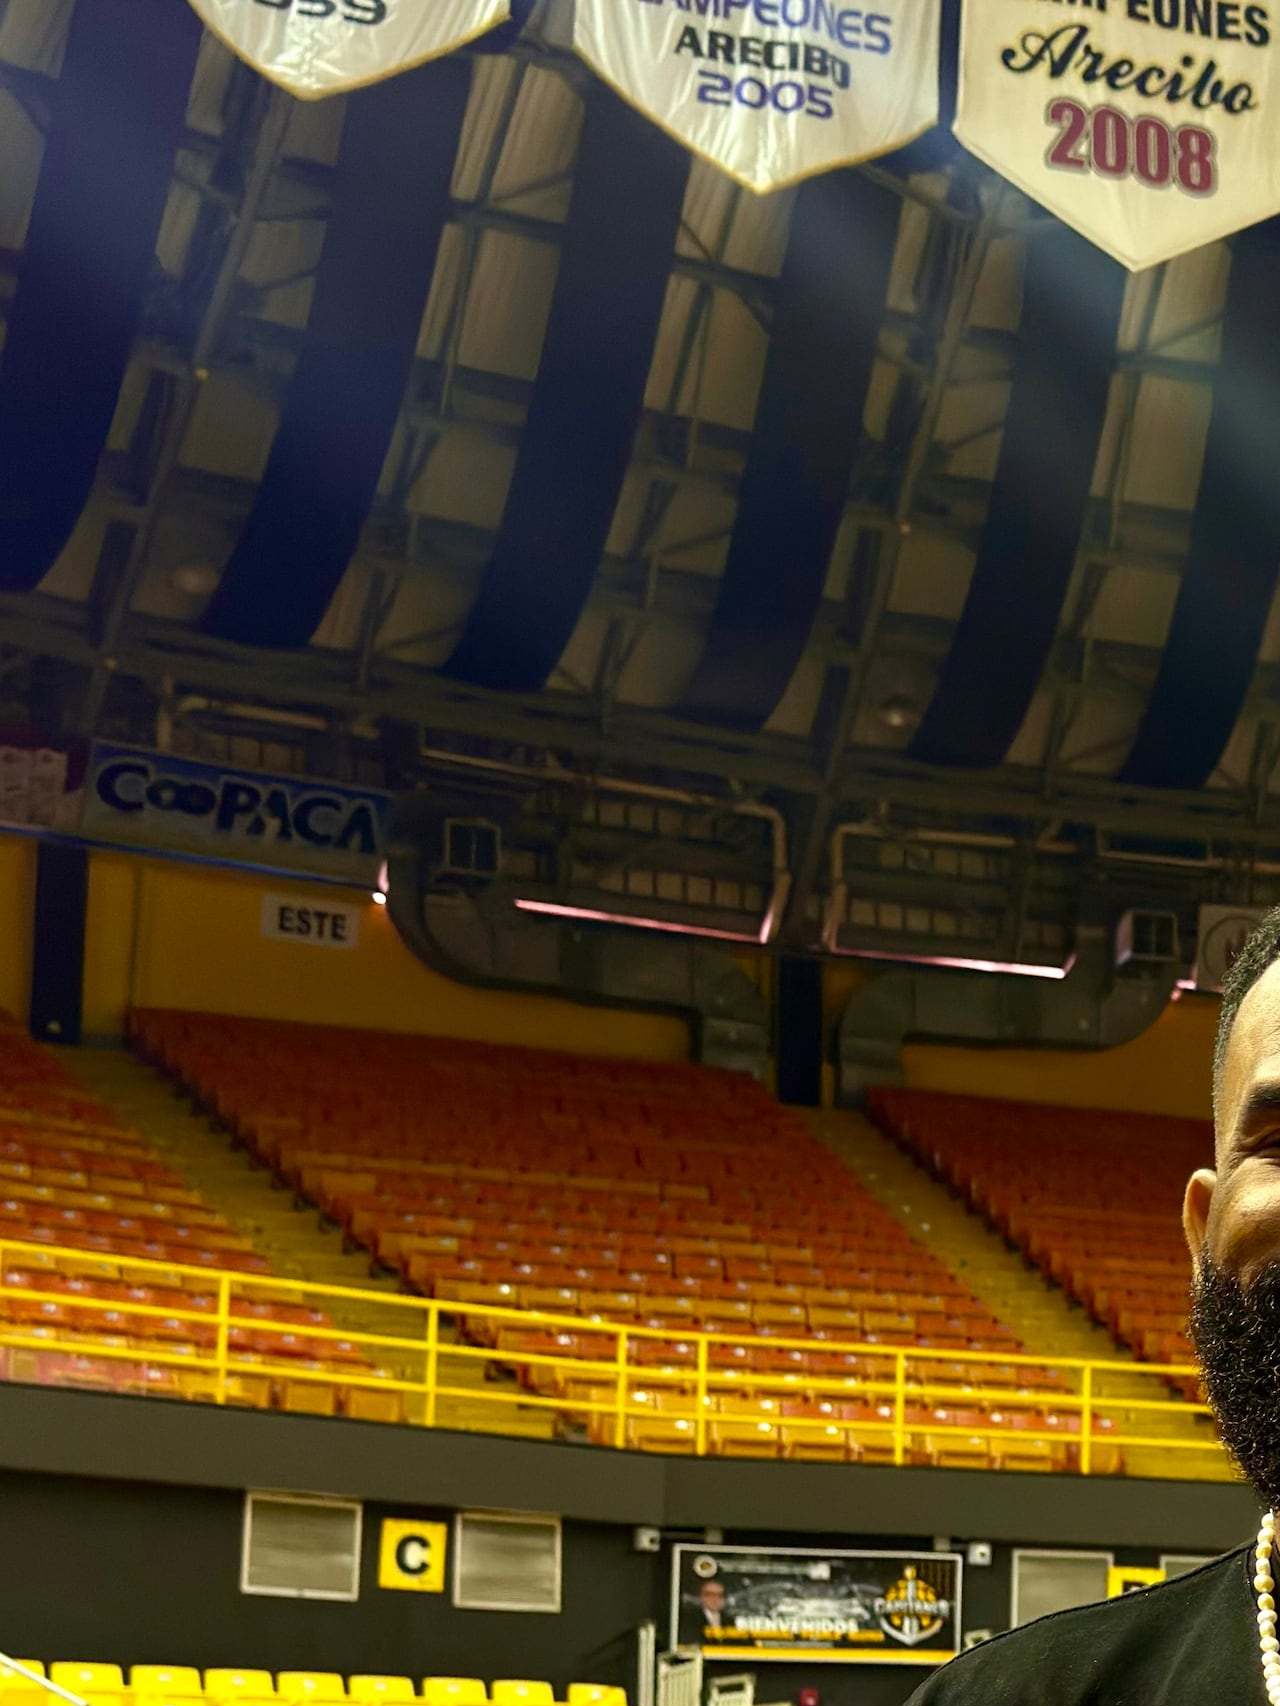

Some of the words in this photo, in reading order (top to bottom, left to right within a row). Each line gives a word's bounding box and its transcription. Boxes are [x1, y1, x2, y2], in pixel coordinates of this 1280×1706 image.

[675, 26, 850, 89] ARECIBO
[1000, 25, 1257, 114] Arecibo
[697, 70, 834, 120] 2005
[1045, 97, 1218, 198] 2008
[278, 906, 348, 942] ESTE
[395, 1534, 431, 1575] C
